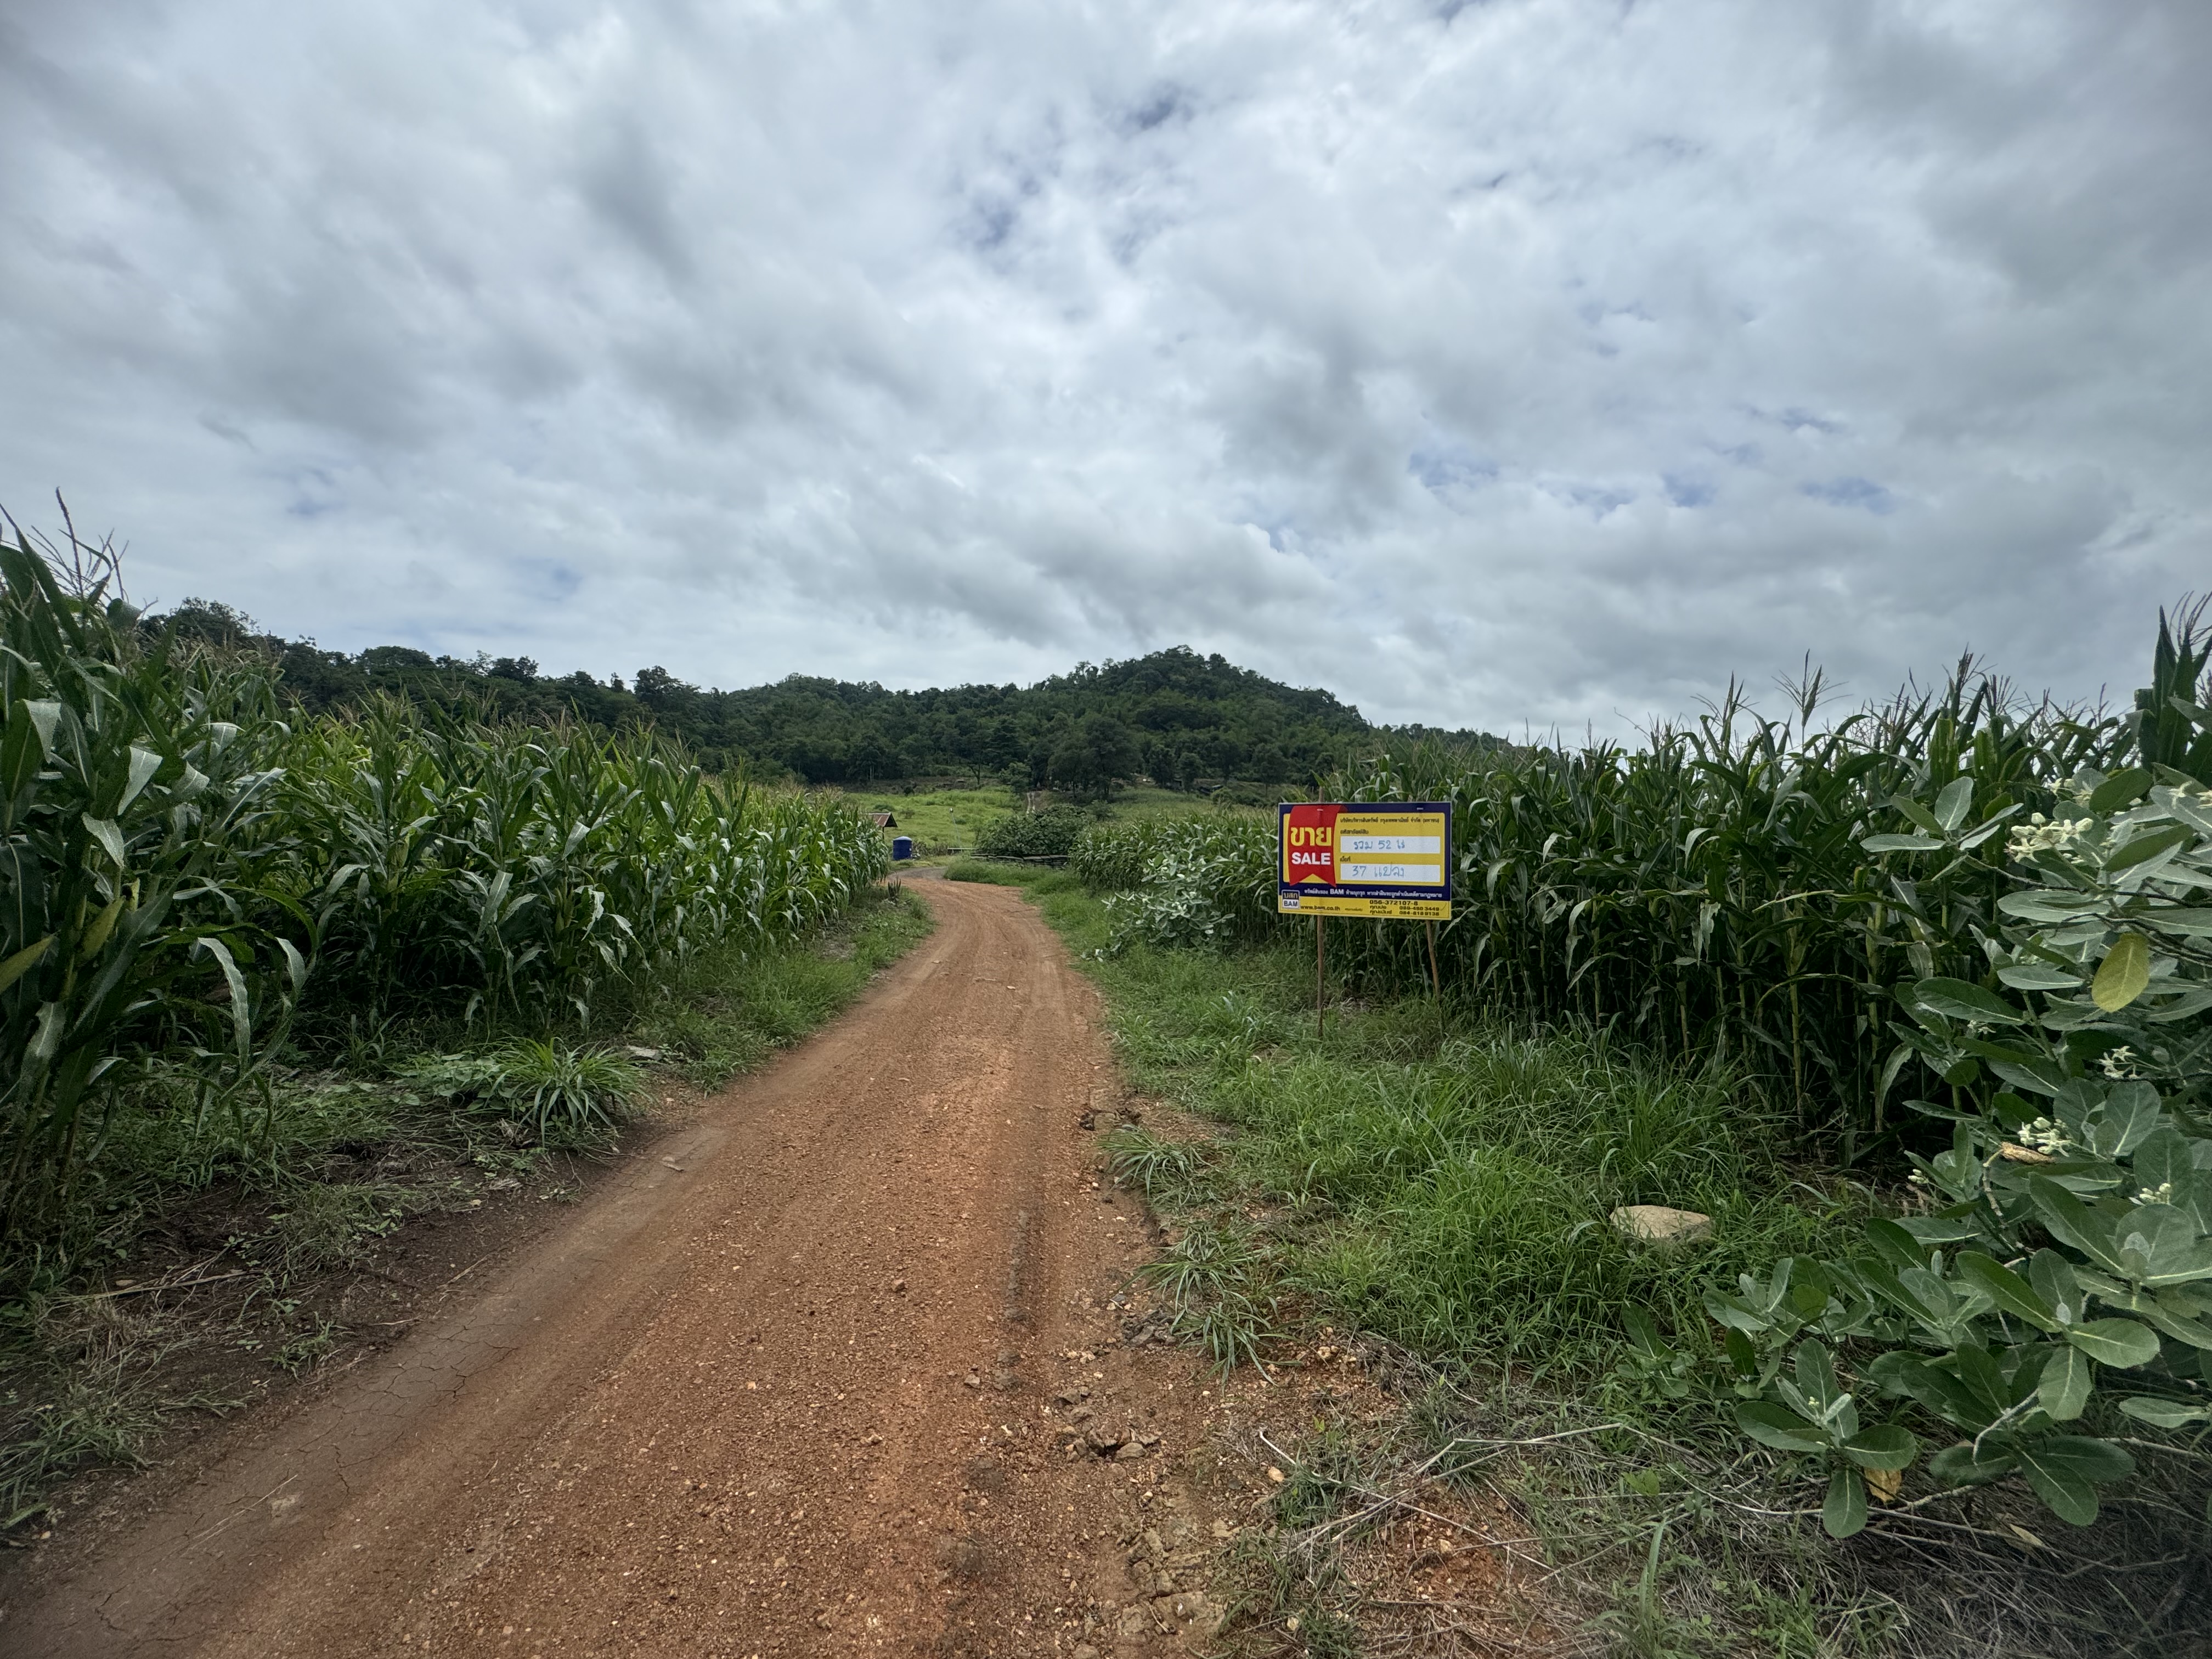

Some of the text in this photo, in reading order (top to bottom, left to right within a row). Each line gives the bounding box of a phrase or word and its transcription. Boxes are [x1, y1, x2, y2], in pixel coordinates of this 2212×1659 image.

[1290, 827, 1331, 846] ขาย
[1353, 839, 1405, 850] รวม 52 ไร่
[1291, 852, 1331, 865] SALE
[1352, 862, 1404, 877] 37 แปลง
